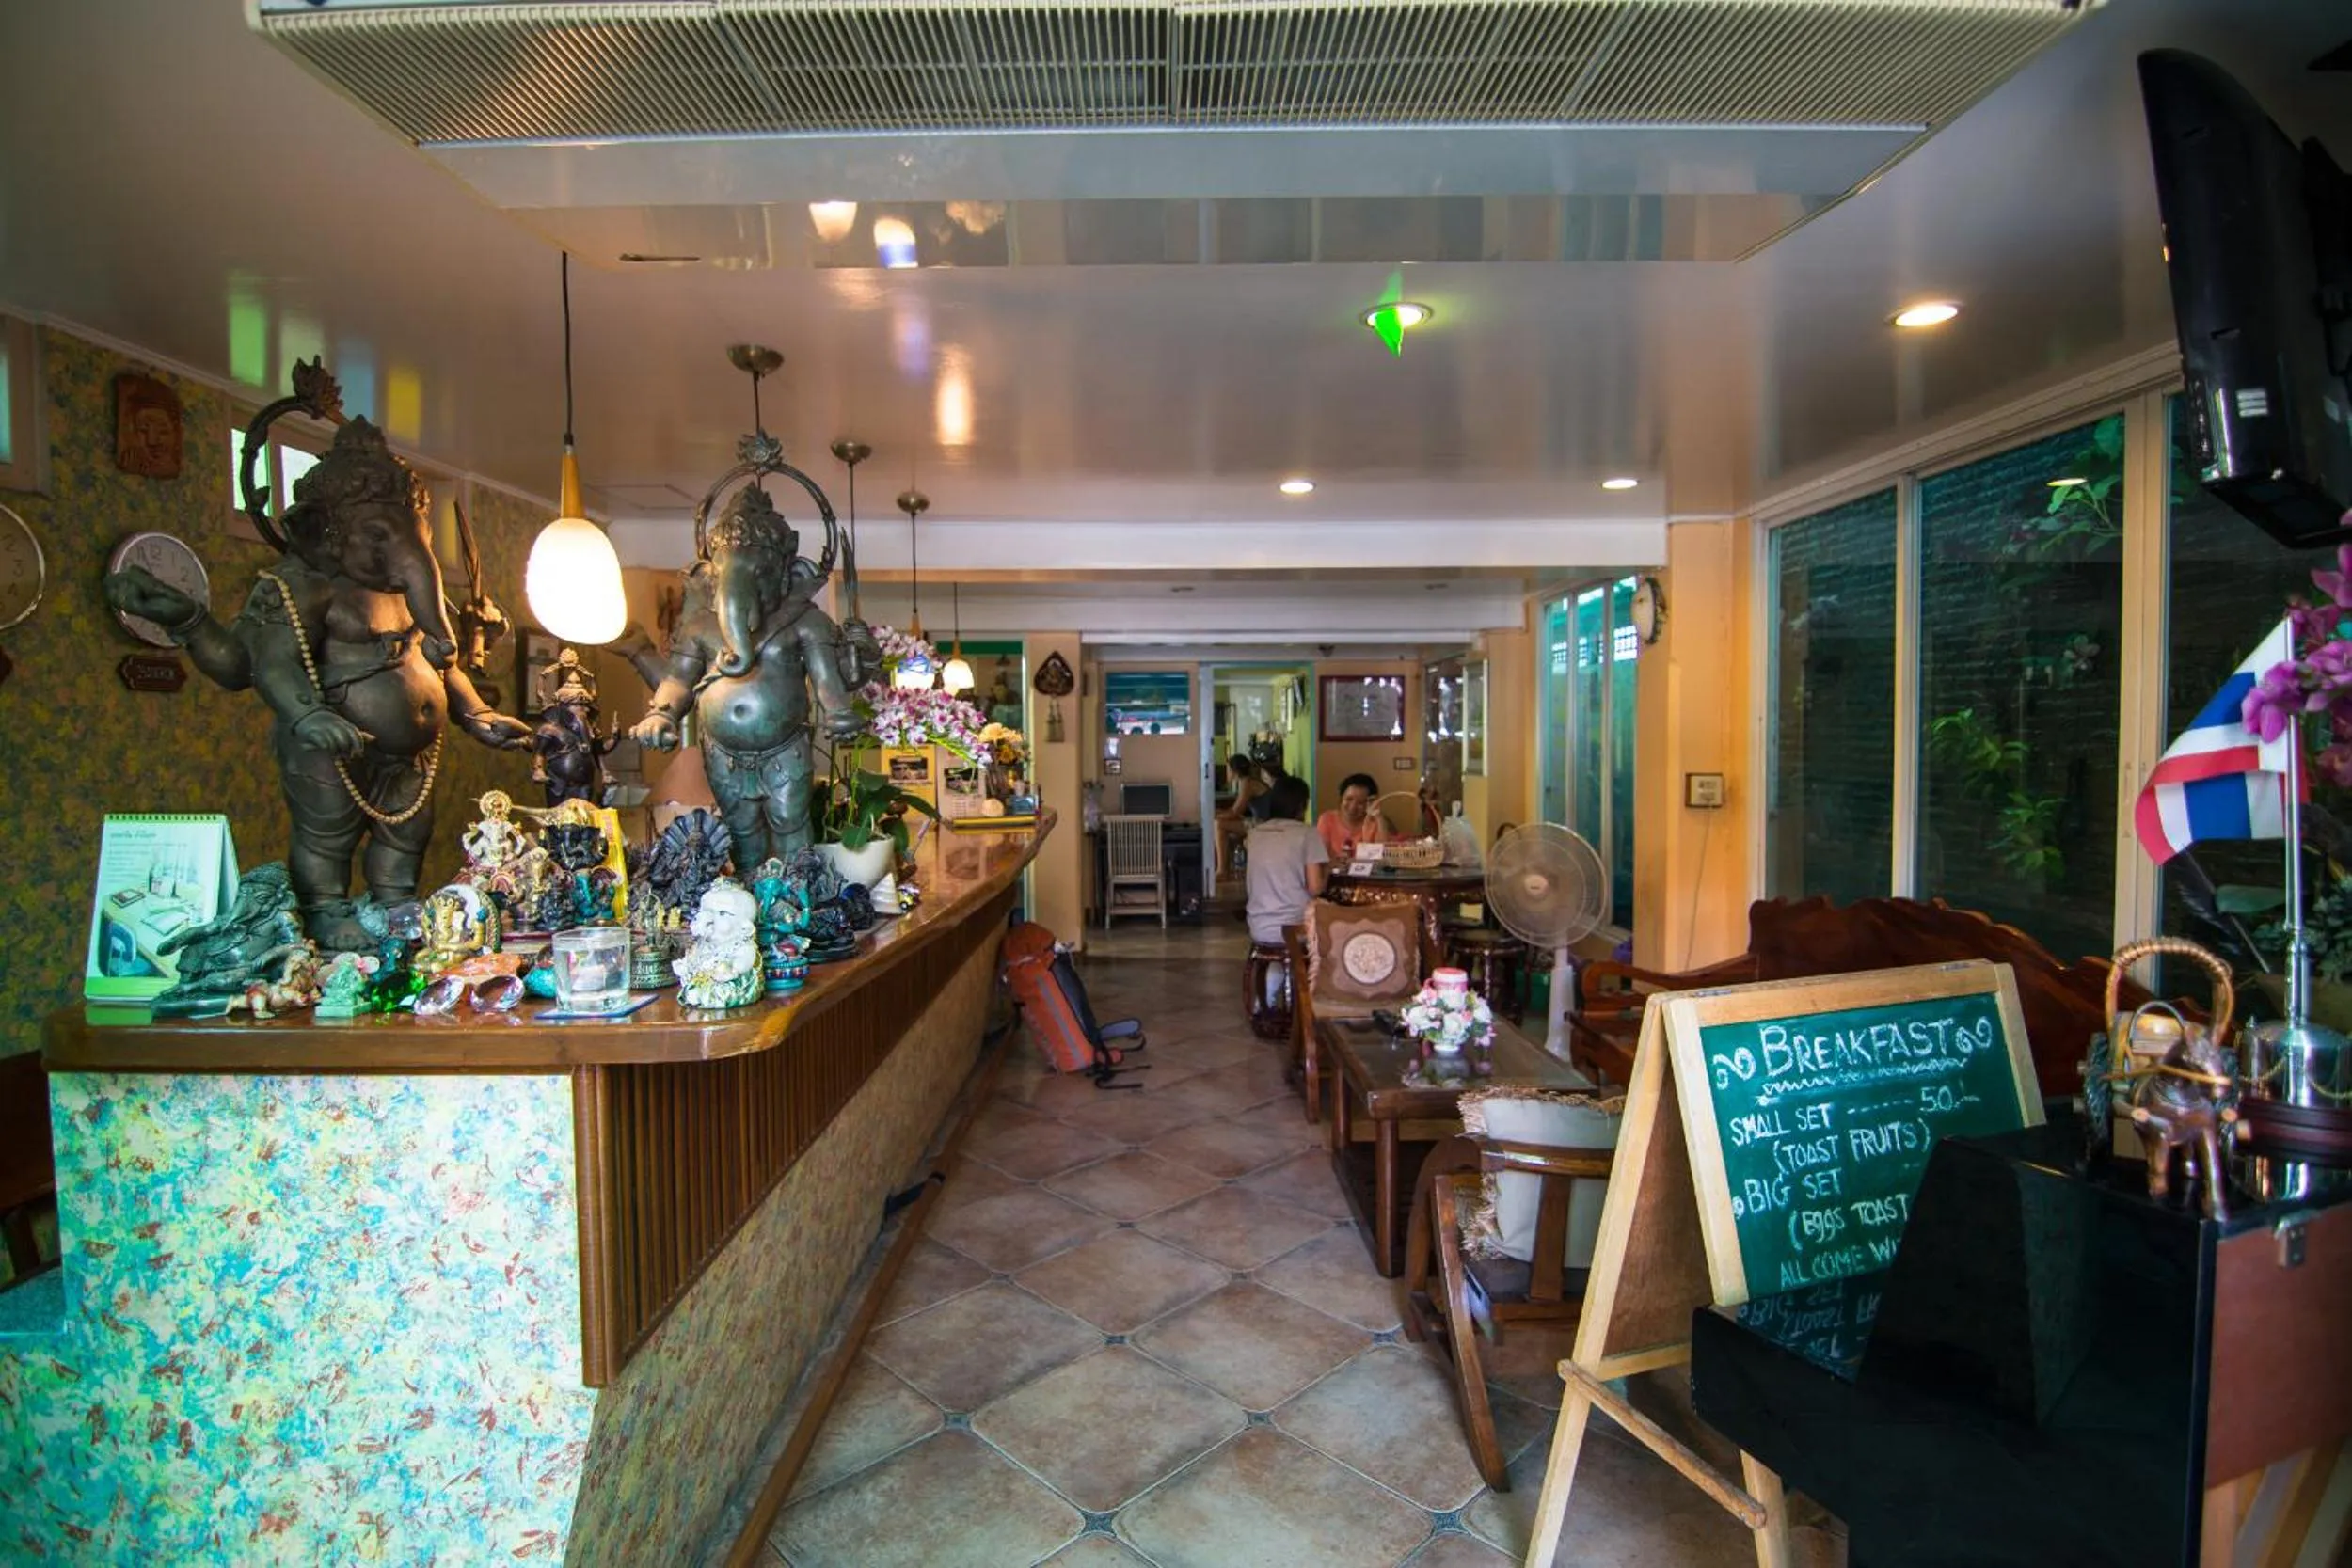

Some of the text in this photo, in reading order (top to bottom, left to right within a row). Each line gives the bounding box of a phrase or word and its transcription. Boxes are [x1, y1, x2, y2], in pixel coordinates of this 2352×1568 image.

[1759, 1017, 1955, 1078] BREAKFAST
[1729, 1109, 1791, 1147] SMALL
[1795, 1102, 1833, 1131] SET
[1744, 1167, 1842, 1214] BIG SET
[1850, 1193, 1910, 1226] TOAST
[1780, 1235, 1902, 1291] ALL COME WI
